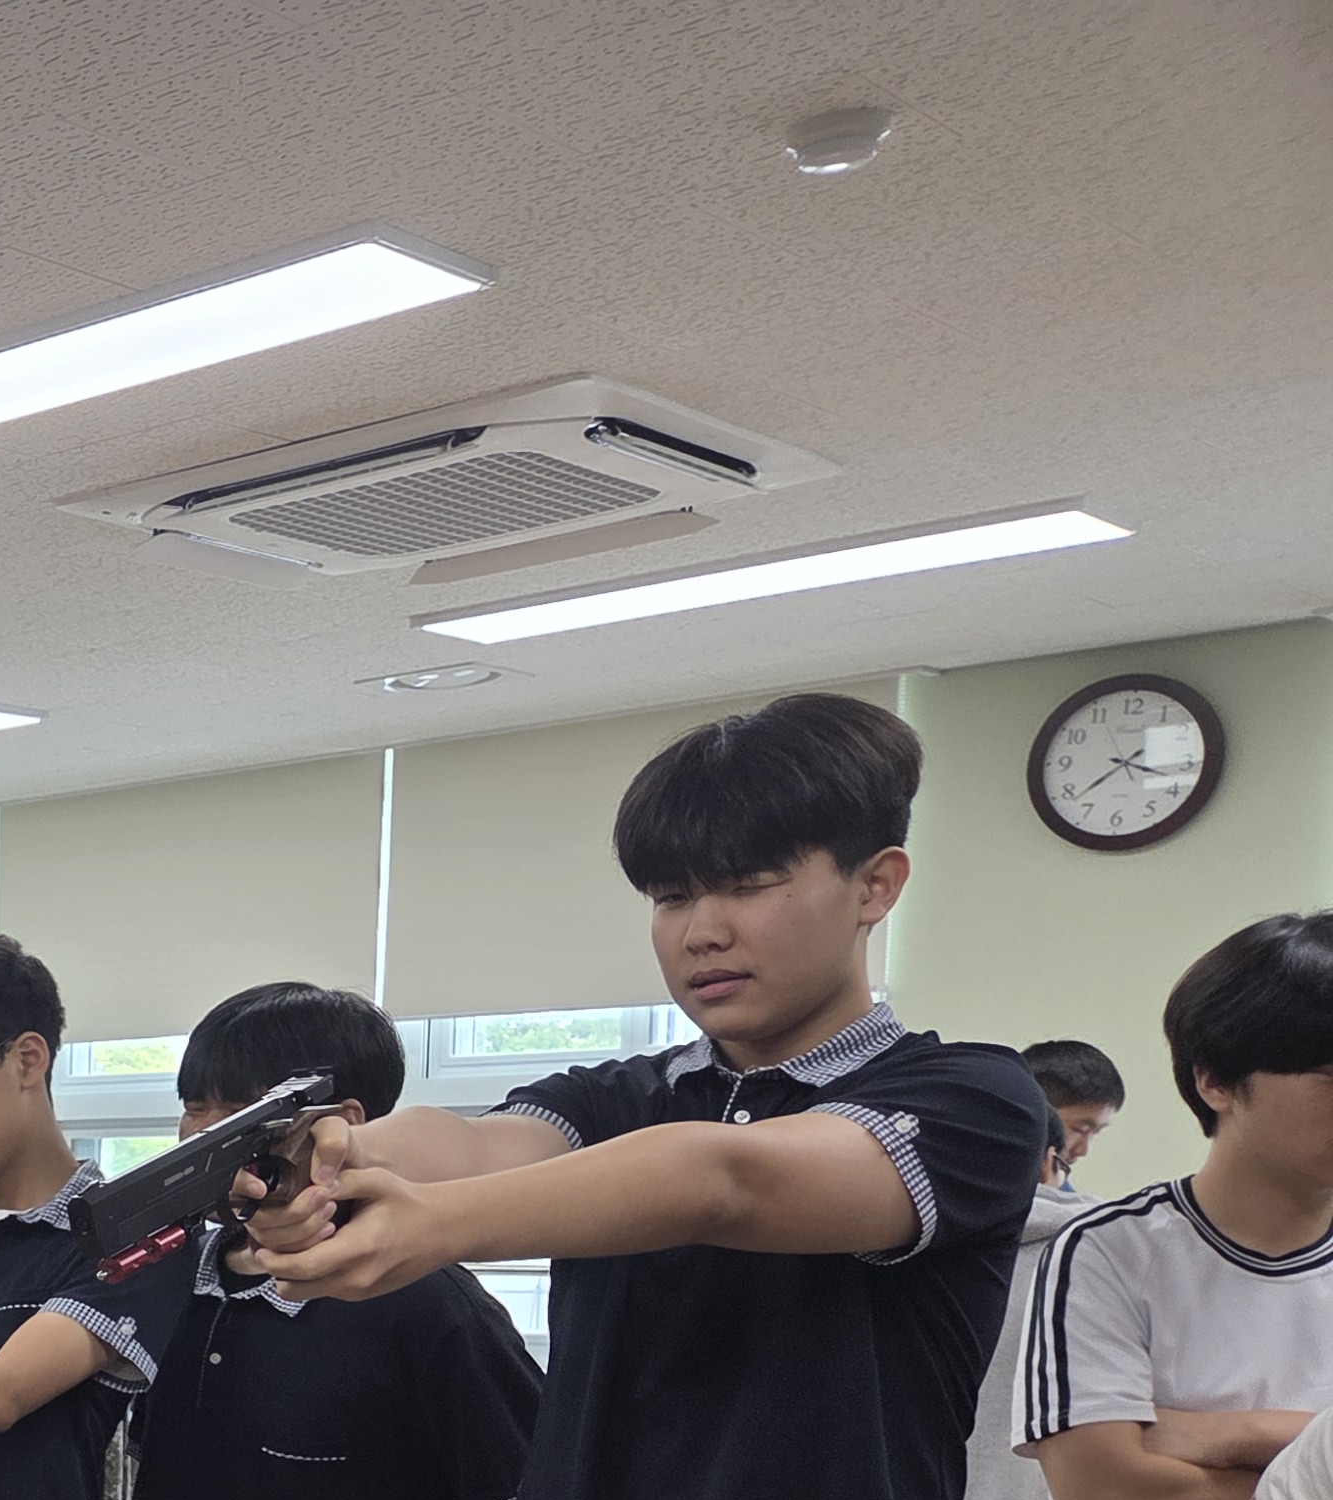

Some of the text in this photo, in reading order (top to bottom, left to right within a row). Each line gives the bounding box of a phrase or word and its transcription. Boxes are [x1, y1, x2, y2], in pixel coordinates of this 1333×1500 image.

[1122, 697, 1144, 715] 12
[1159, 705, 1168, 723] 1
[1091, 708, 1107, 724] 11
[1067, 728, 1086, 745] 10
[1058, 755, 1073, 773] 9
[1061, 783, 1077, 800] 8
[1165, 782, 1180, 798] 4
[1081, 803, 1095, 819] 7
[1142, 800, 1157, 817] 5
[1109, 809, 1123, 827] 6
